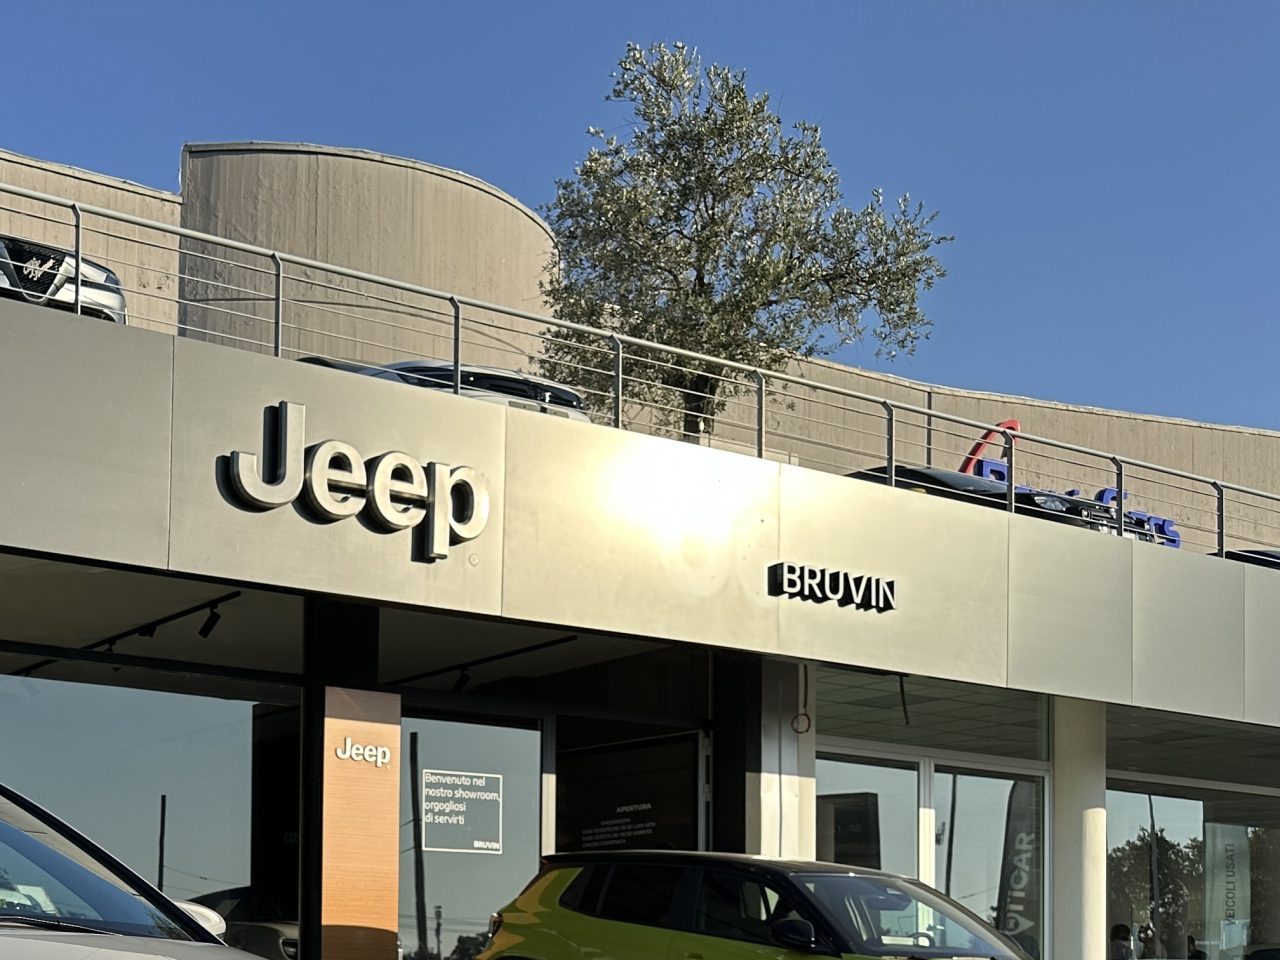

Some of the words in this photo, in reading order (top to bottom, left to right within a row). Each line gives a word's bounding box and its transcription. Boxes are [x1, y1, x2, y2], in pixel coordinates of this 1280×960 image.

[229, 400, 490, 559] Jeep
[782, 561, 897, 610] BRUVIN
[335, 736, 391, 768] Jeep
[425, 773, 472, 786] Benvenuto
[472, 776, 486, 787] nel
[425, 787, 453, 798] nostro
[424, 800, 467, 813] orgogliosi
[425, 812, 434, 823] di
[434, 813, 465, 825] servirti
[473, 840, 500, 850] BRUVIN
[1224, 843, 1236, 878] USATI
[1224, 881, 1237, 927] VEICOLI
